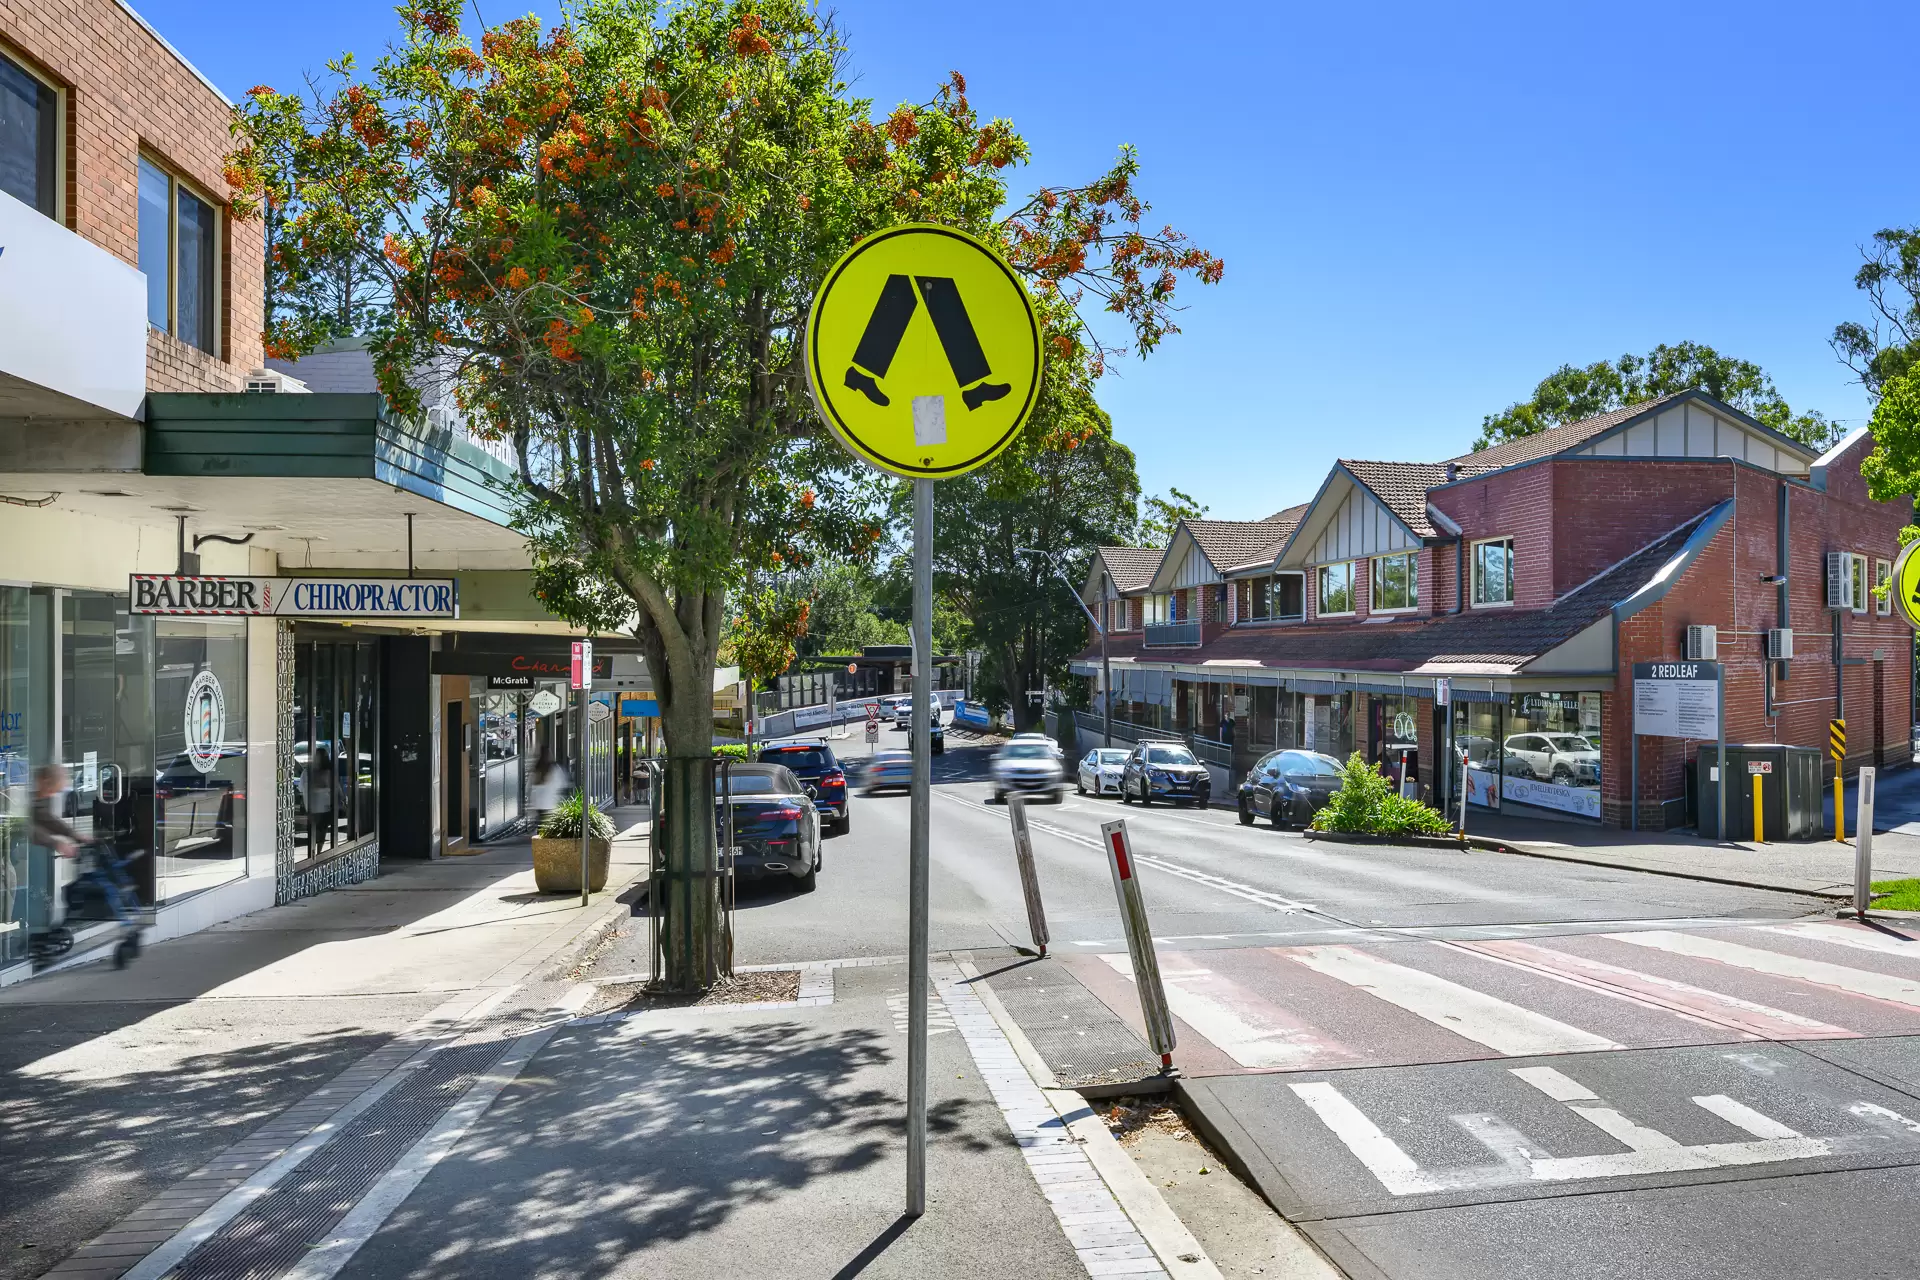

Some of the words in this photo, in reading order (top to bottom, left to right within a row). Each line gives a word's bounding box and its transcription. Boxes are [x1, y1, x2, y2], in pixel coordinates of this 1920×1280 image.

[135, 579, 258, 610] BARBER
[294, 583, 452, 612] CHIROPRACTOR
[511, 656, 604, 673] Chard
[1651, 664, 1657, 678] 2
[1659, 664, 1698, 678] REDLEAF
[492, 676, 529, 685] McGrath
